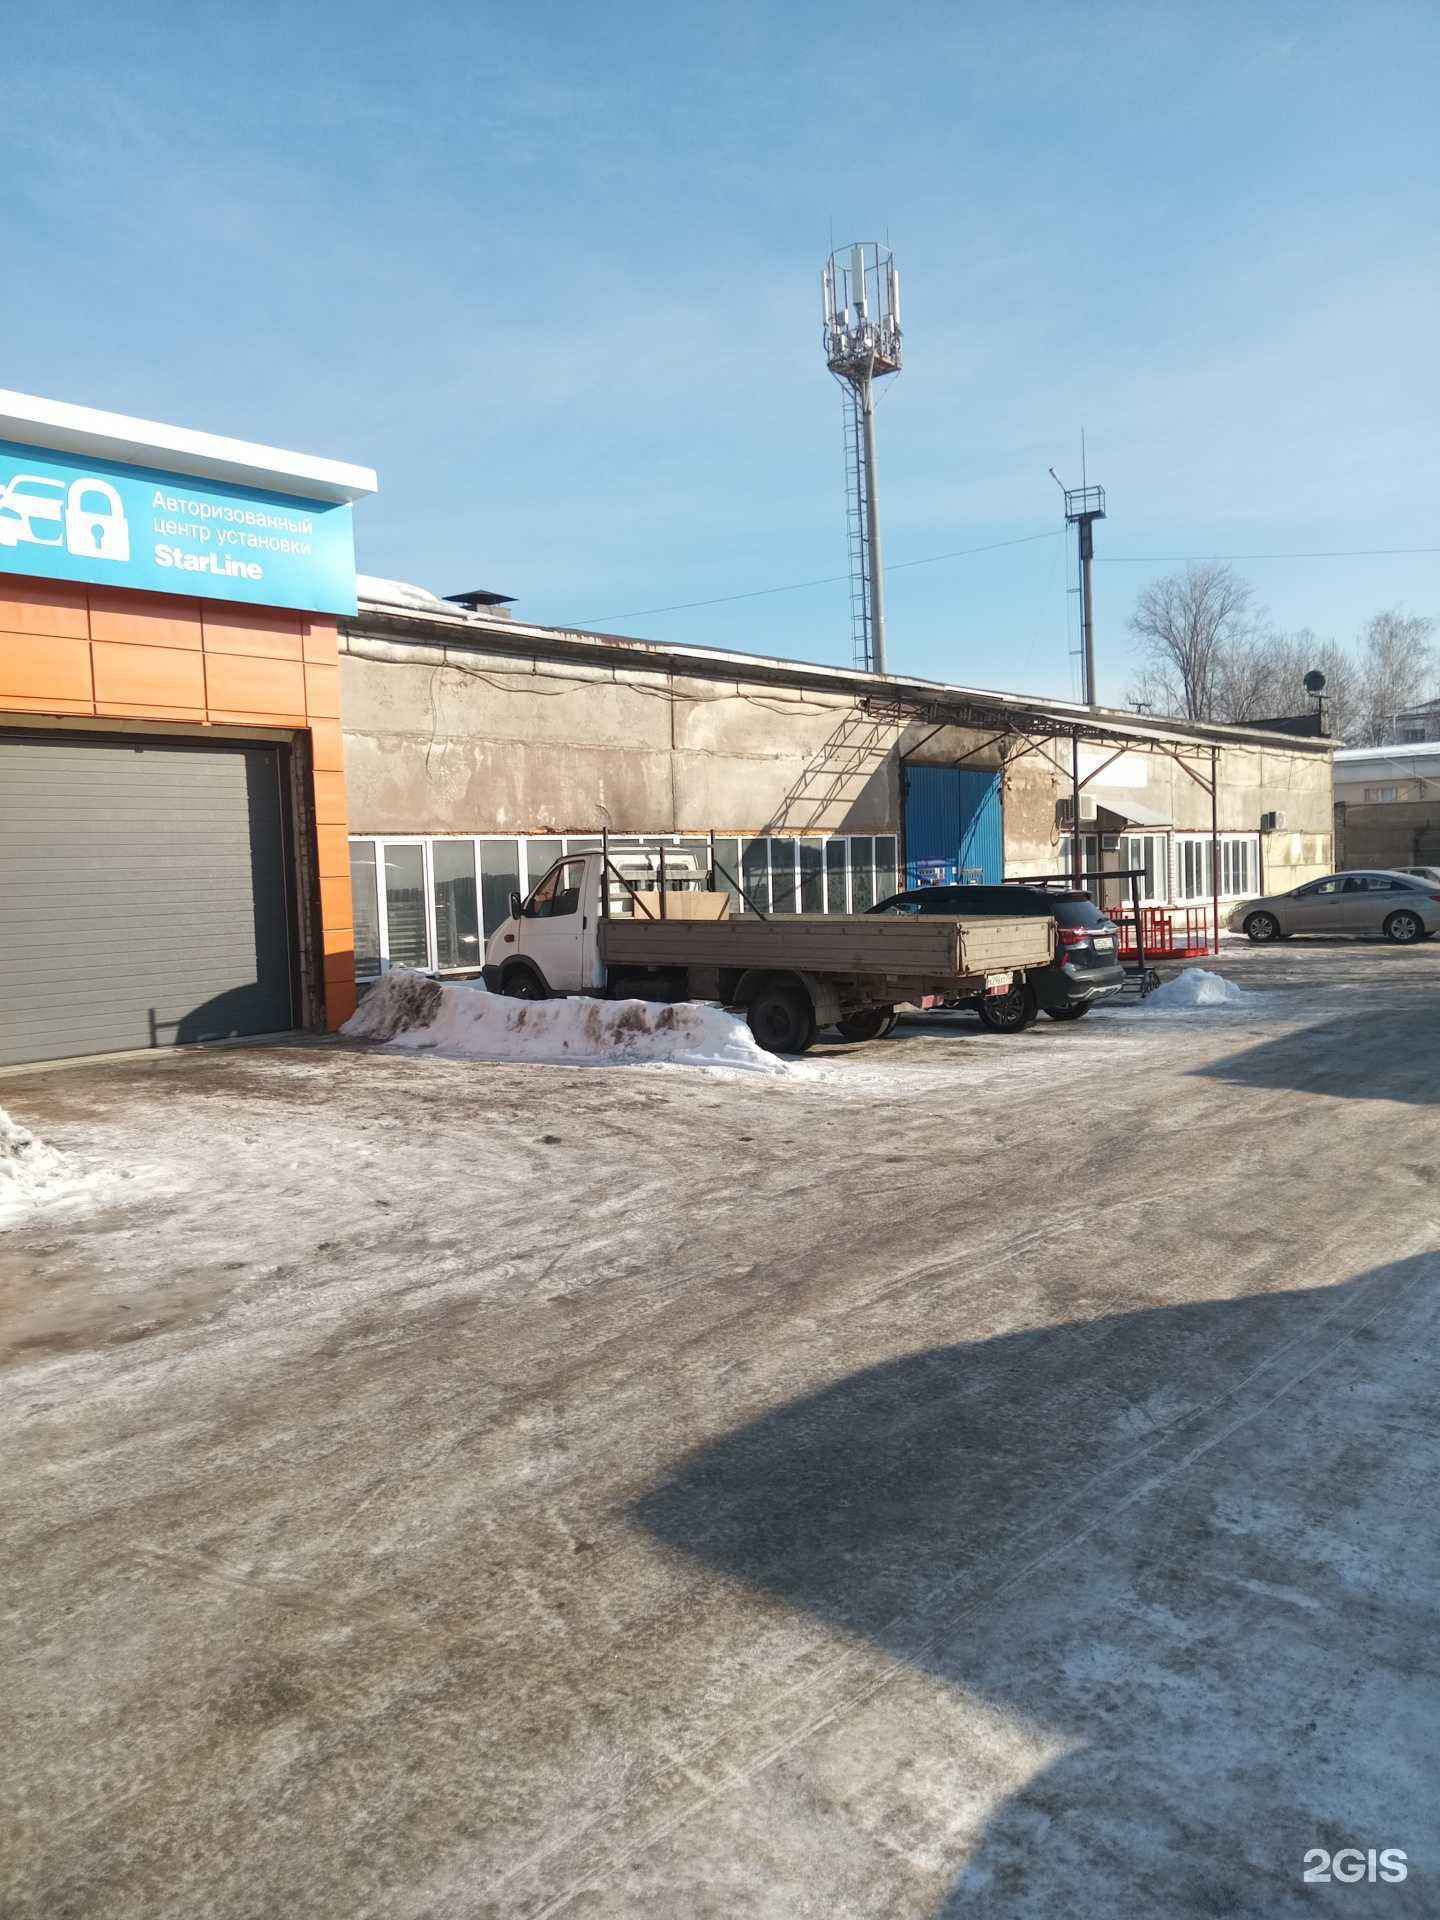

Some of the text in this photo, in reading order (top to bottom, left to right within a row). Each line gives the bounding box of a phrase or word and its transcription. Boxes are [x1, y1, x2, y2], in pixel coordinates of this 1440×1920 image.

[152, 490, 313, 535] Авторизованный
[153, 517, 312, 556] центр установки
[154, 543, 264, 580] StarLine
